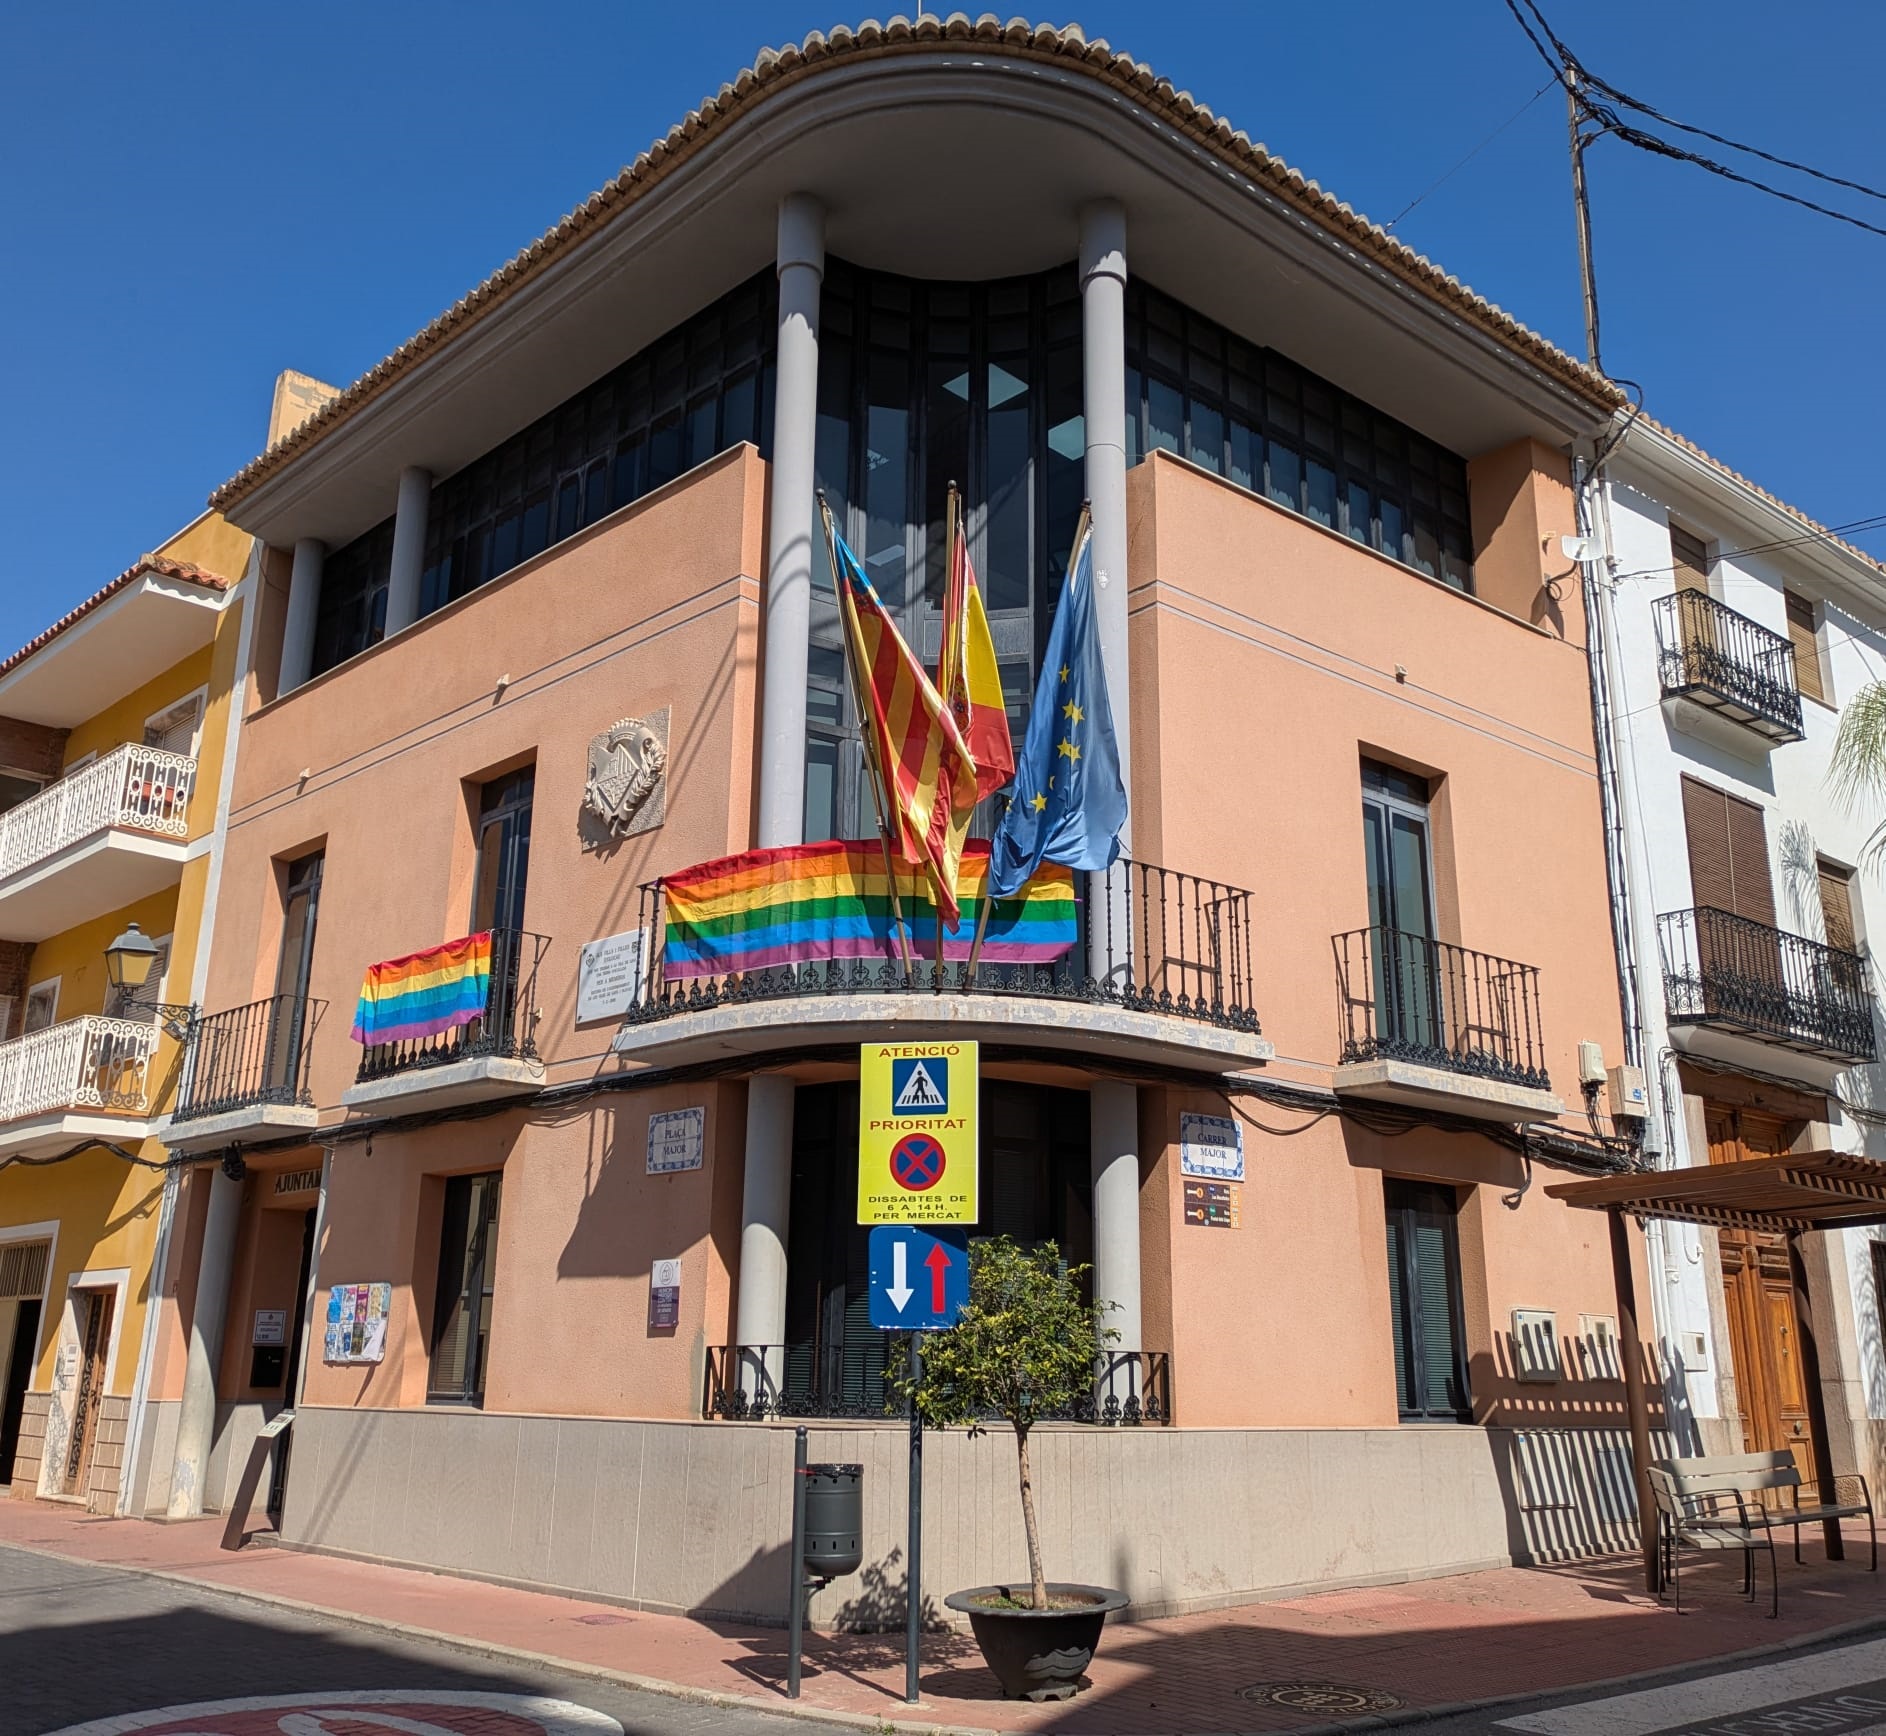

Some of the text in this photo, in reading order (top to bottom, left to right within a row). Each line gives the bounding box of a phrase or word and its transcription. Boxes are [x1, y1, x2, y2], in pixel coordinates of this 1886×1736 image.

[878, 1044, 960, 1058] ATENCIÓ
[869, 1119, 967, 1131] PRIORITAT
[1197, 1132, 1227, 1145] CARRER
[664, 1145, 686, 1155] MAJOR
[1200, 1147, 1227, 1159] MAJOR
[868, 1195, 968, 1203] DISSABTES DE
[907, 1211, 962, 1219] MERCAT
